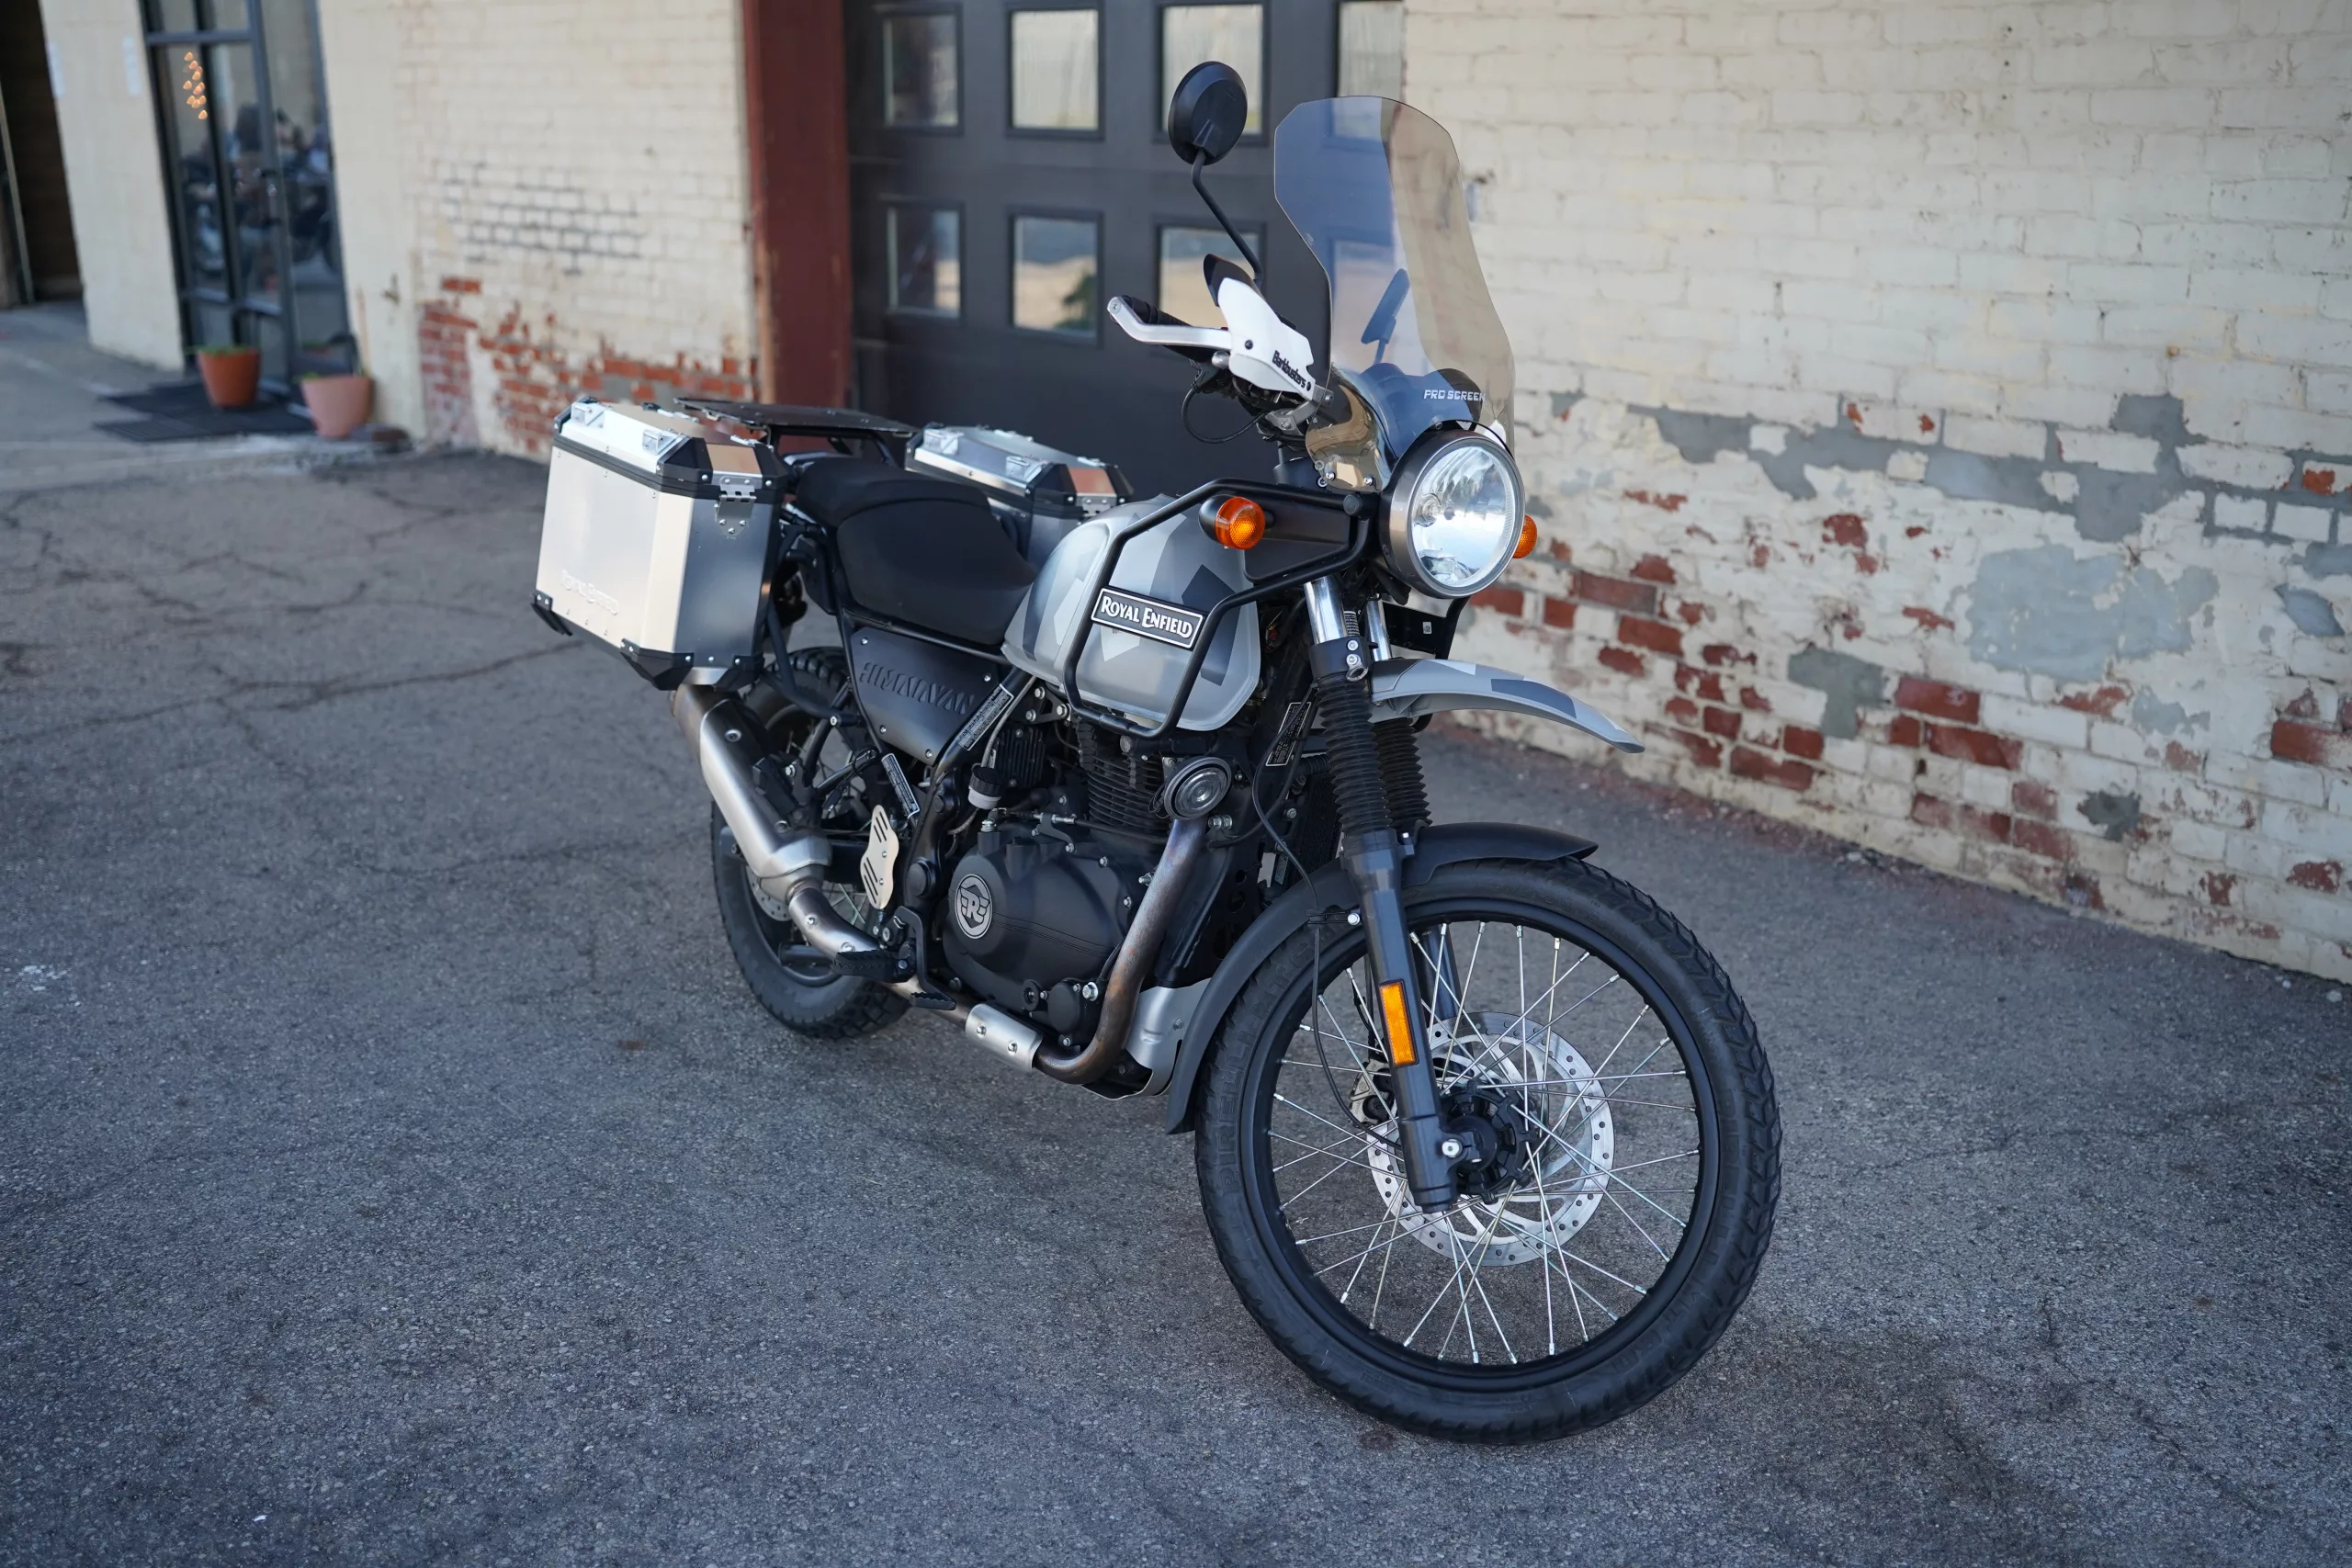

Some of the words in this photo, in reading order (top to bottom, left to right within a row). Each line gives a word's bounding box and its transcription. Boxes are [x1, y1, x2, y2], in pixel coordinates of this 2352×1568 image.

[1272, 350, 1306, 389] Barkbusters
[1424, 389, 1445, 400] PRO
[1447, 390, 1486, 402] SCREEN
[1101, 596, 1139, 622] ROYAL
[1142, 607, 1193, 638] ENFIELD
[859, 661, 975, 715] HIMALAYAN
[1217, 1029, 1257, 1195] PIRELLI
